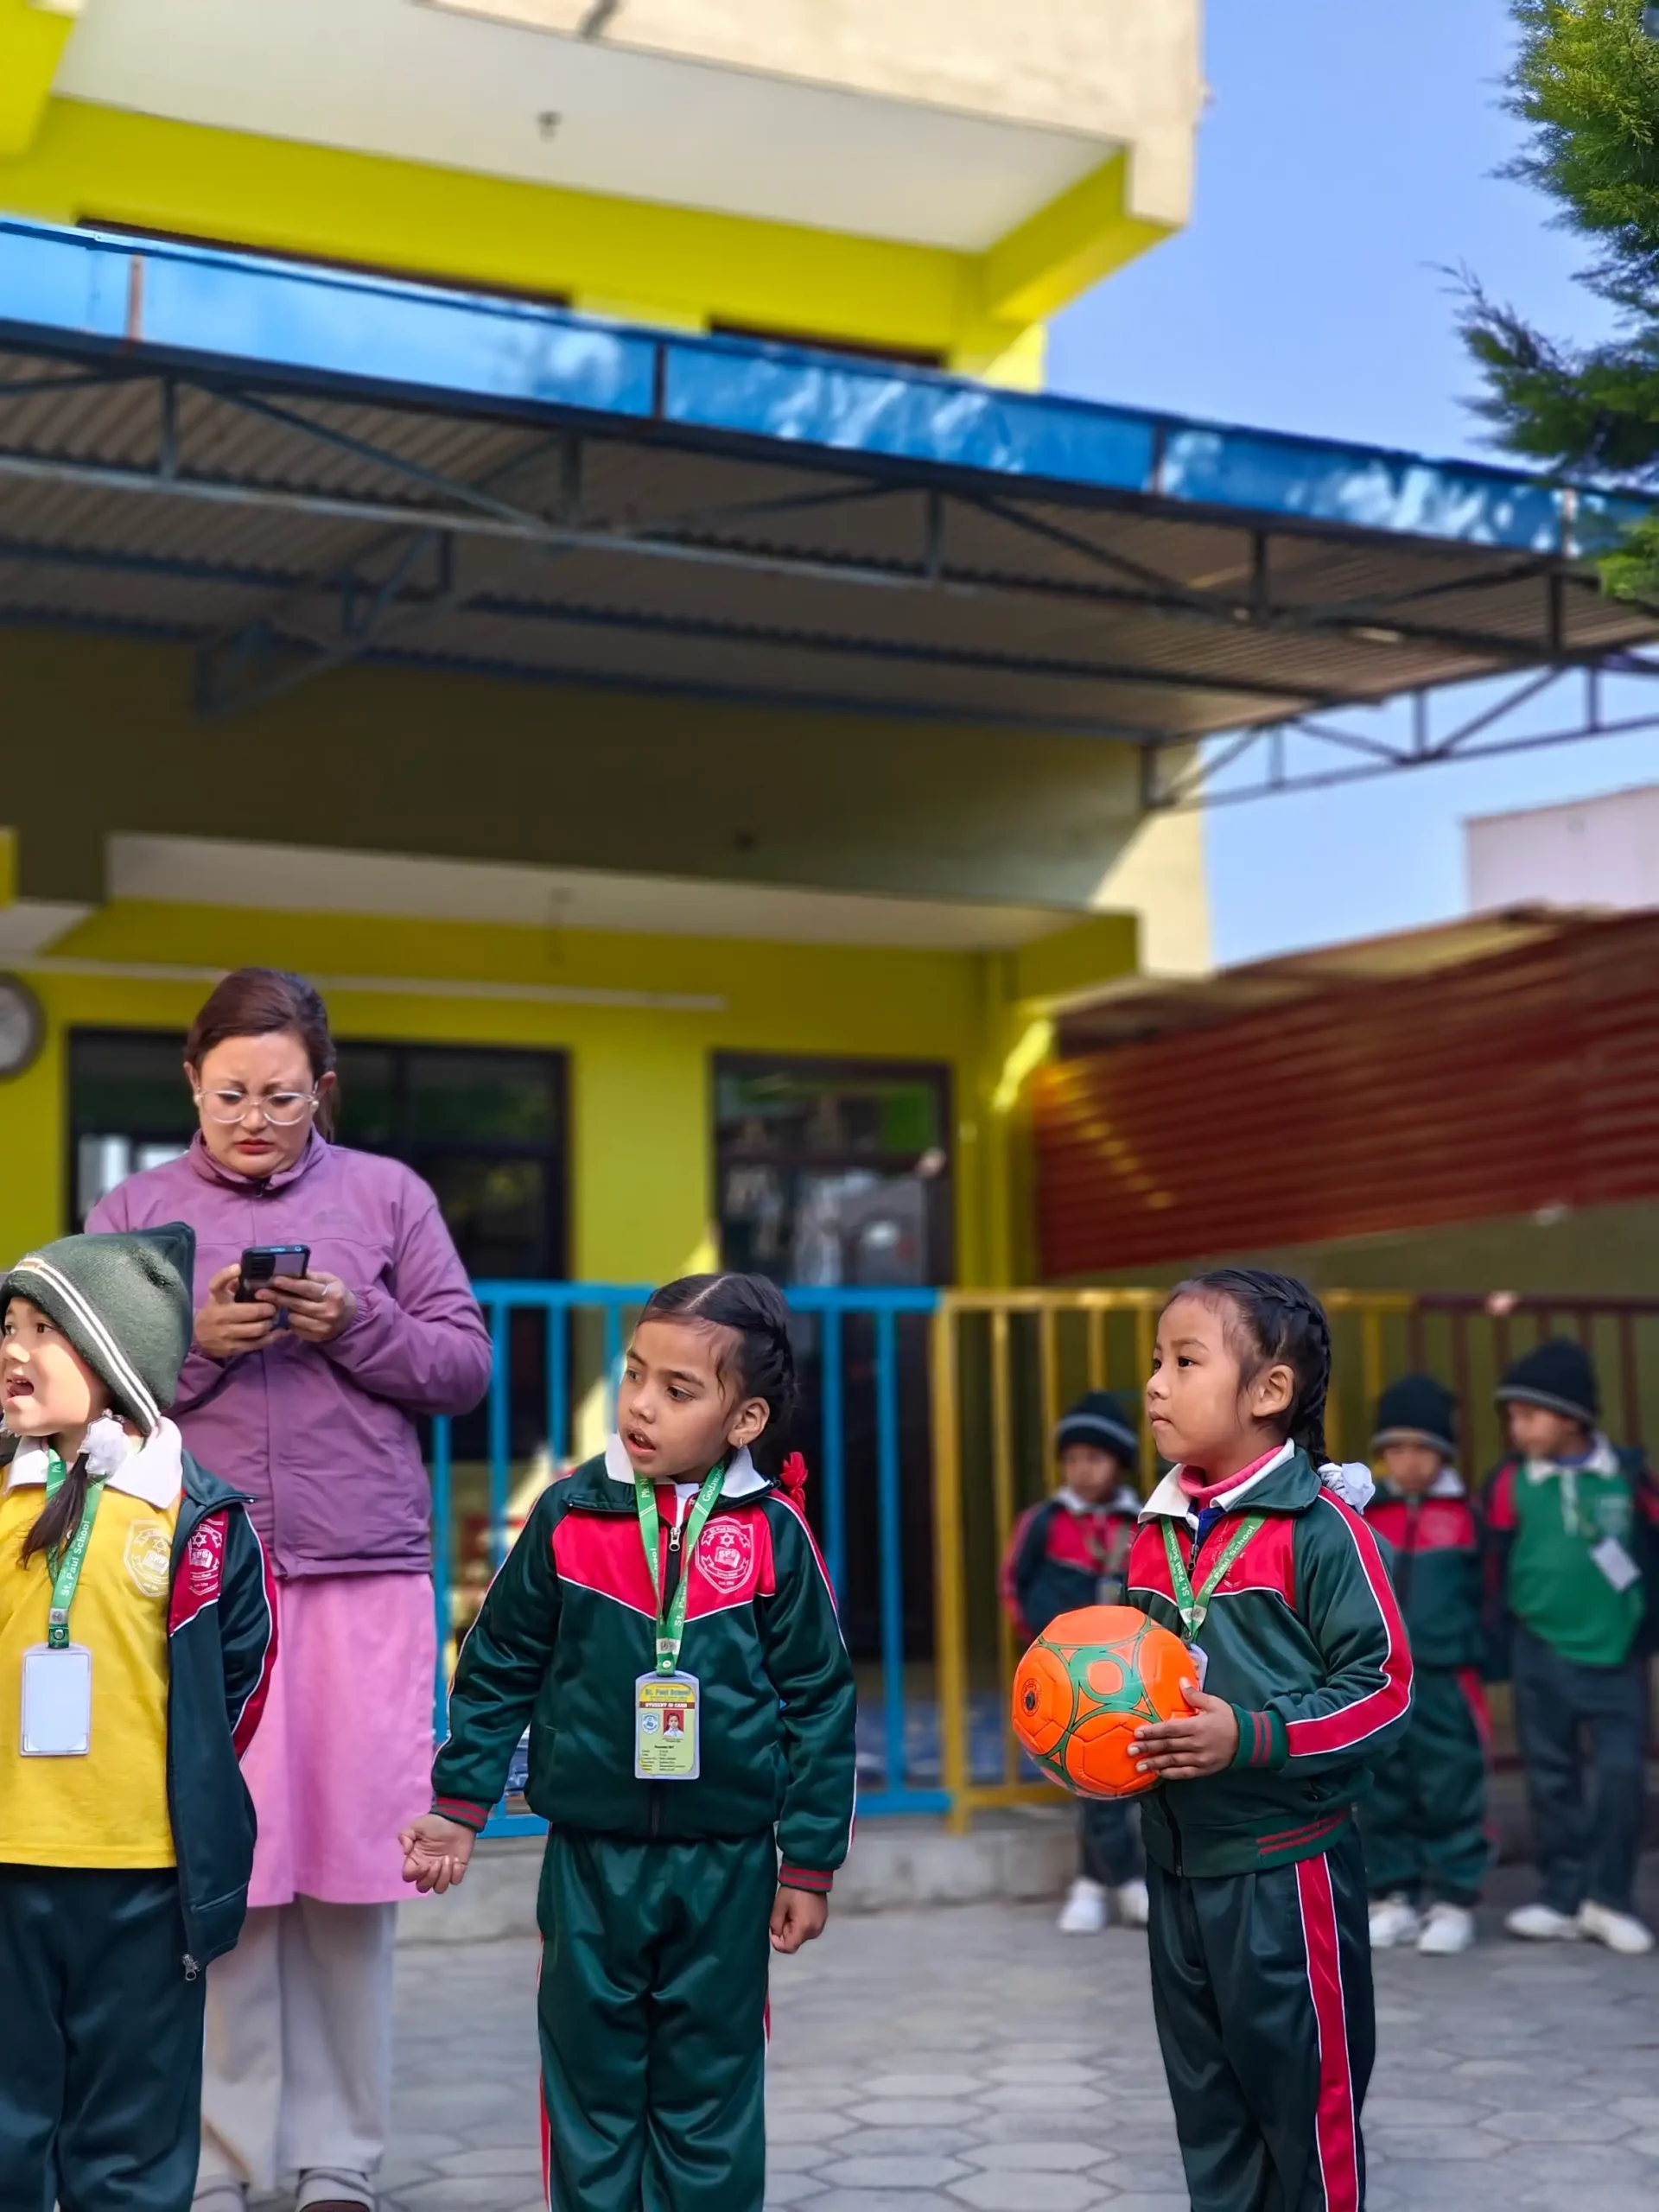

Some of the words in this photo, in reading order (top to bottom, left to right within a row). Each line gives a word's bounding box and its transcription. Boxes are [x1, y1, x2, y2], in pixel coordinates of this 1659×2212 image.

[61, 1582, 73, 1596] St.
[67, 1557, 79, 1580] Paul
[74, 1520, 91, 1554] School
[1167, 1530, 1179, 1561] School
[1175, 1561, 1185, 1582] Paul
[1205, 1581, 1215, 1594] St.
[1214, 1558, 1230, 1579] Paul
[1229, 1525, 1255, 1556] School
[1181, 1582, 1190, 1597] St.
[675, 1612, 683, 1627] St.
